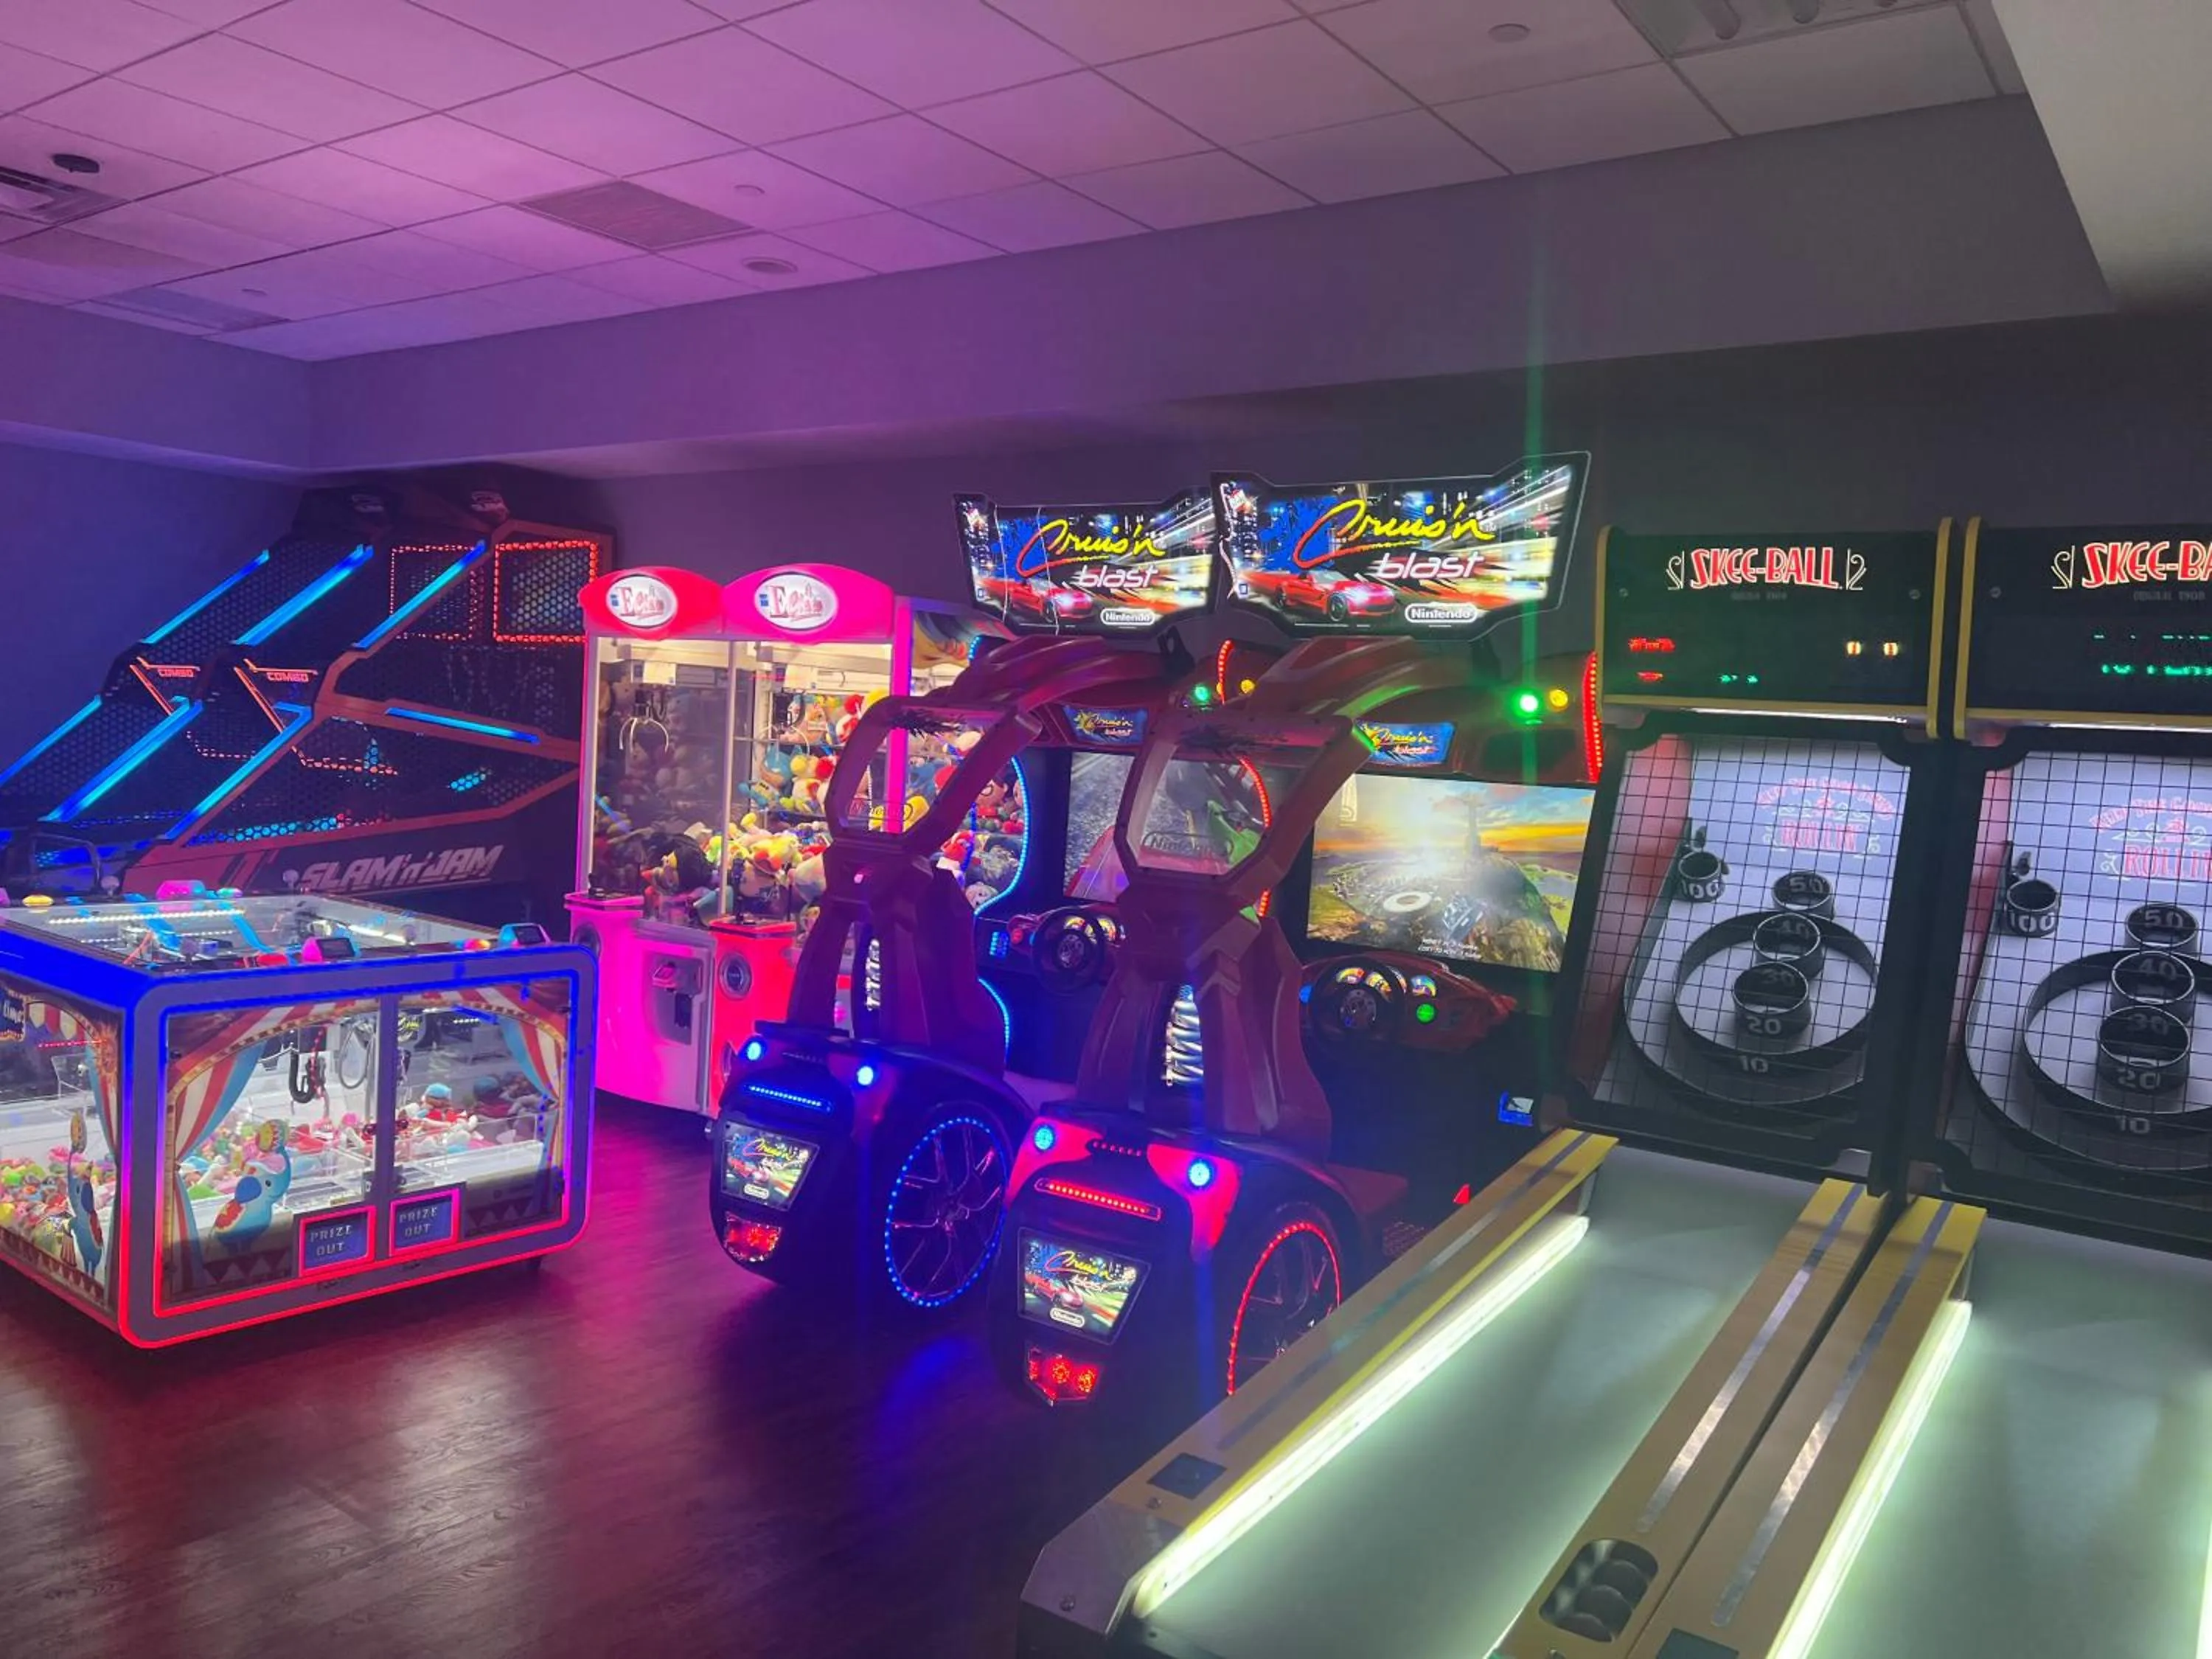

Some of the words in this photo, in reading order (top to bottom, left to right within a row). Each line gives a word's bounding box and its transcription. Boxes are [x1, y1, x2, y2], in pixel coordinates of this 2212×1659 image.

[1293, 498, 1496, 568] Cruis'n
[1016, 519, 1165, 577] Cruis'n
[1376, 552, 1484, 580] blast
[1691, 547, 1840, 589] SKEE-BALL
[1076, 565, 1158, 588] blast
[1105, 610, 1150, 622] Nintendo
[1411, 608, 1471, 619] Nintendo
[267, 672, 309, 682] COMBO
[1790, 877, 1824, 894] 50
[2010, 912, 2055, 933] 100
[2144, 909, 2183, 929] 50
[1746, 1016, 1781, 1034] 20
[1740, 1056, 1769, 1072] 10
[2118, 1067, 2160, 1090] 20
[2118, 1116, 2151, 1134] 10
[399, 1207, 437, 1223] PRIZE
[310, 1225, 352, 1242] PRIZE
[405, 1223, 431, 1237] OUT
[316, 1242, 345, 1256] OUT
